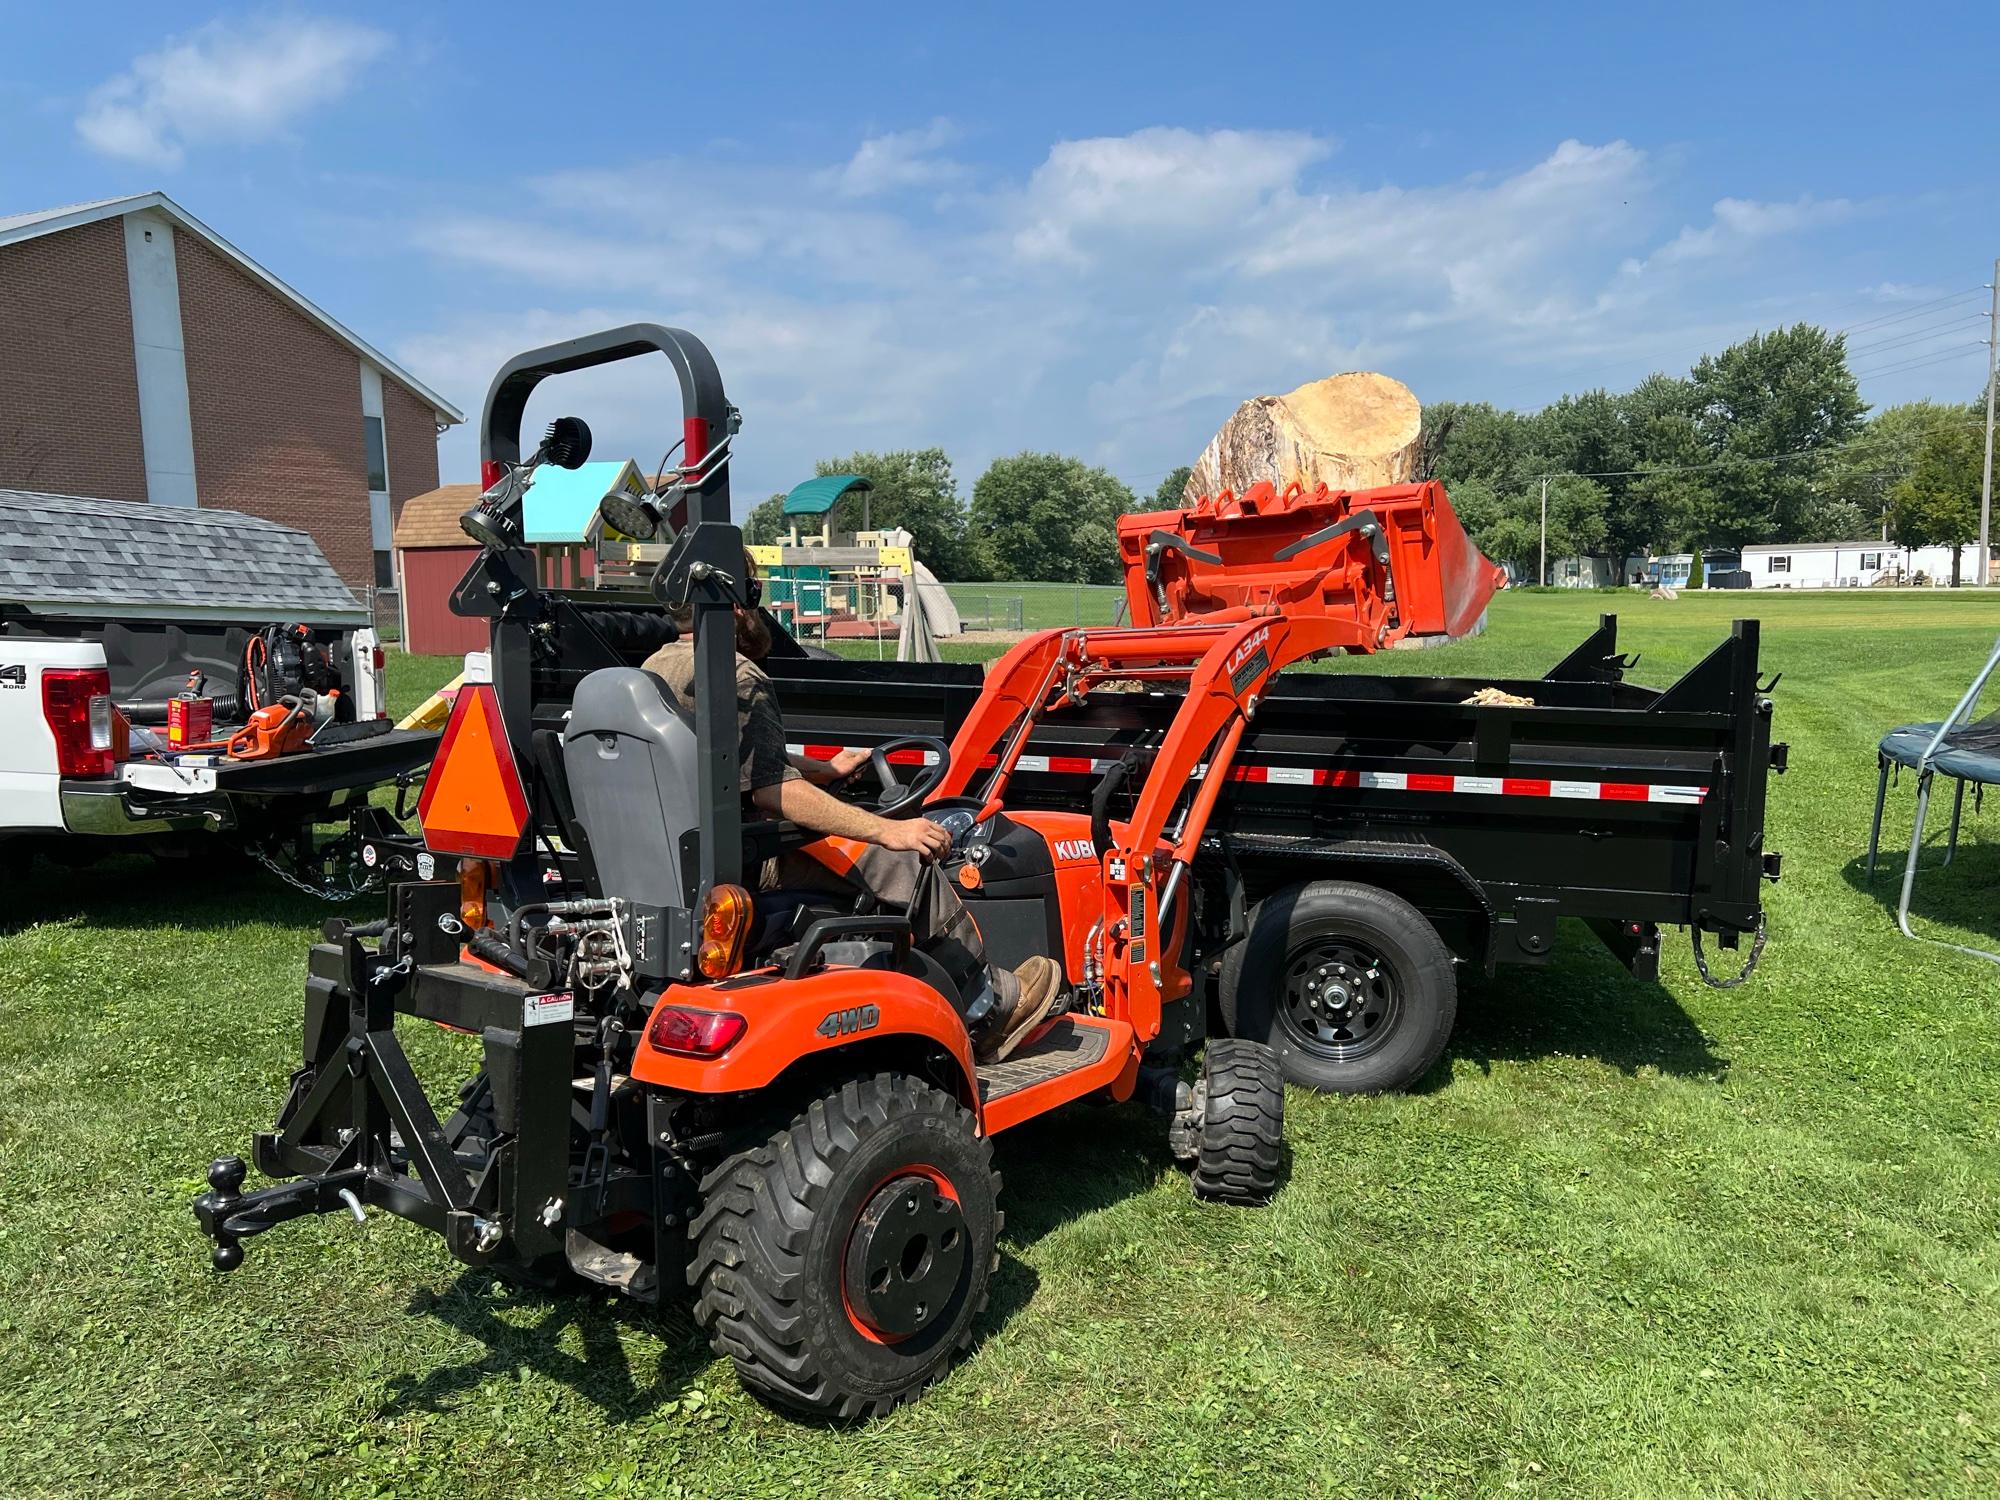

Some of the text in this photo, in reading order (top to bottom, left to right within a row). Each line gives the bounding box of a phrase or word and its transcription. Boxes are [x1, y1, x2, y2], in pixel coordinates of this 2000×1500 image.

[1226, 626, 1270, 674] LA344
[0, 664, 26, 684] 4
[1053, 838, 1119, 861] KUB
[816, 1003, 880, 1039] 4WD
